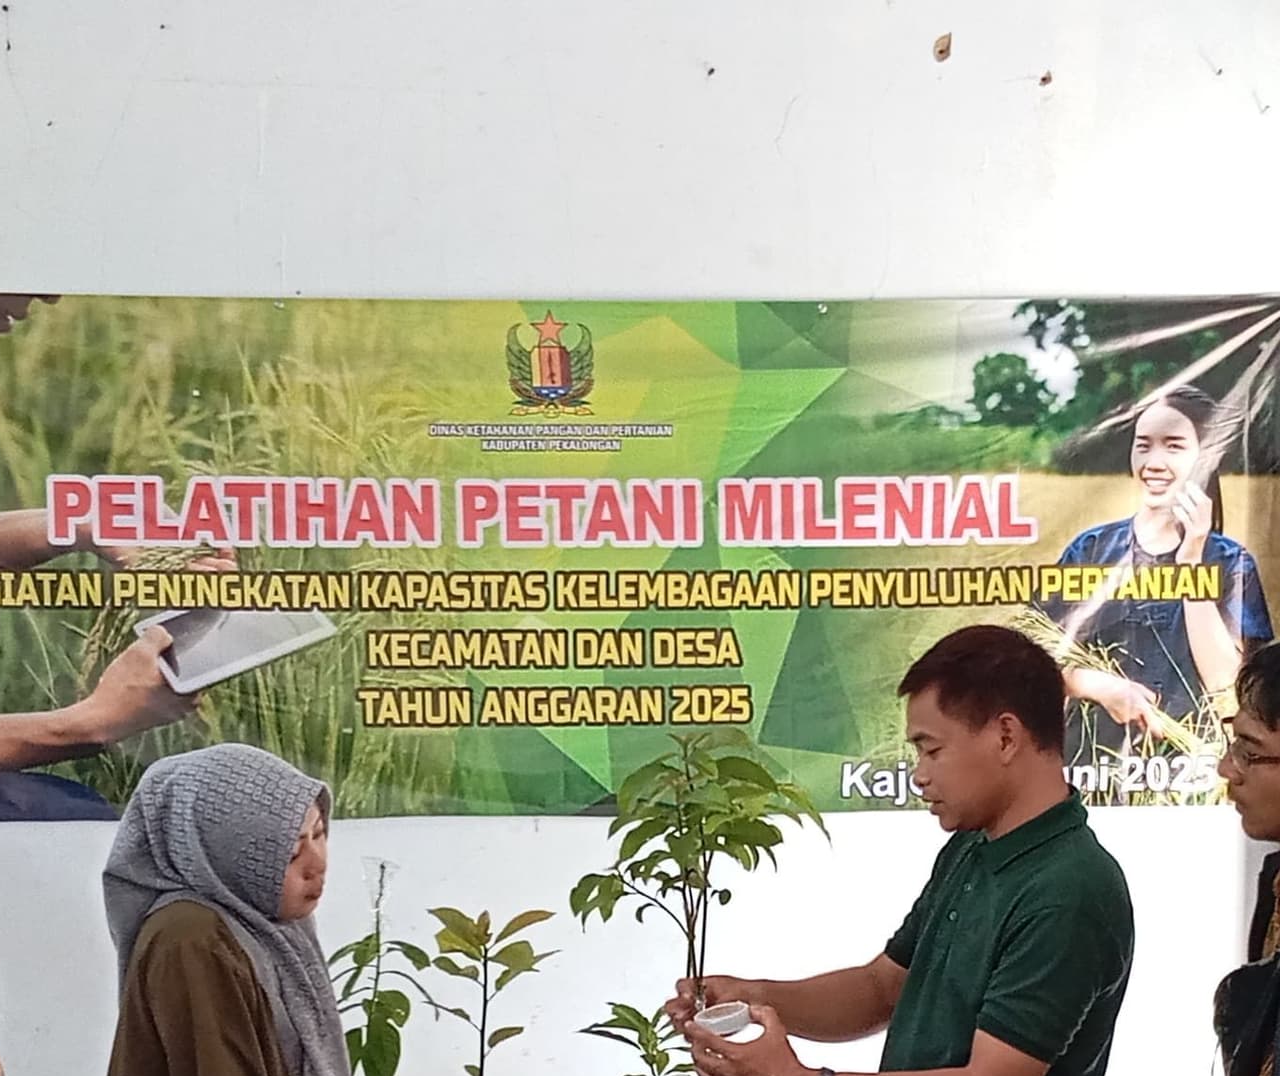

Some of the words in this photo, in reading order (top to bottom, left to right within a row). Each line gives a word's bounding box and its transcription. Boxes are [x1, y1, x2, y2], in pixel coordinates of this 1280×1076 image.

[429, 424, 465, 436] DINAS
[466, 424, 535, 436] KETAHANAN
[536, 424, 584, 436] PANGAN
[584, 424, 609, 436] DAN
[610, 424, 673, 436] PERTANIAN
[481, 440, 547, 451] KABUPATEN
[548, 440, 622, 451] PEKALONGAN
[48, 476, 441, 547] PELATIHAN
[456, 478, 703, 548] PETANI
[719, 475, 1038, 547] MILENIAL
[112, 570, 352, 610] PENINGKATAN
[360, 571, 548, 610] KAPASITAS
[556, 570, 801, 610] KELEMBAGAAN
[808, 567, 1032, 609] PENYULUHAN
[1040, 564, 1220, 602] PERTANIAN
[367, 629, 570, 668] KECAMATAN
[575, 629, 645, 668] DAN
[652, 629, 742, 667] DESA
[358, 688, 472, 726] TAHUN
[479, 688, 667, 725] ANGGARAN
[670, 687, 753, 724] 2025
[1120, 756, 1219, 792] 2025
